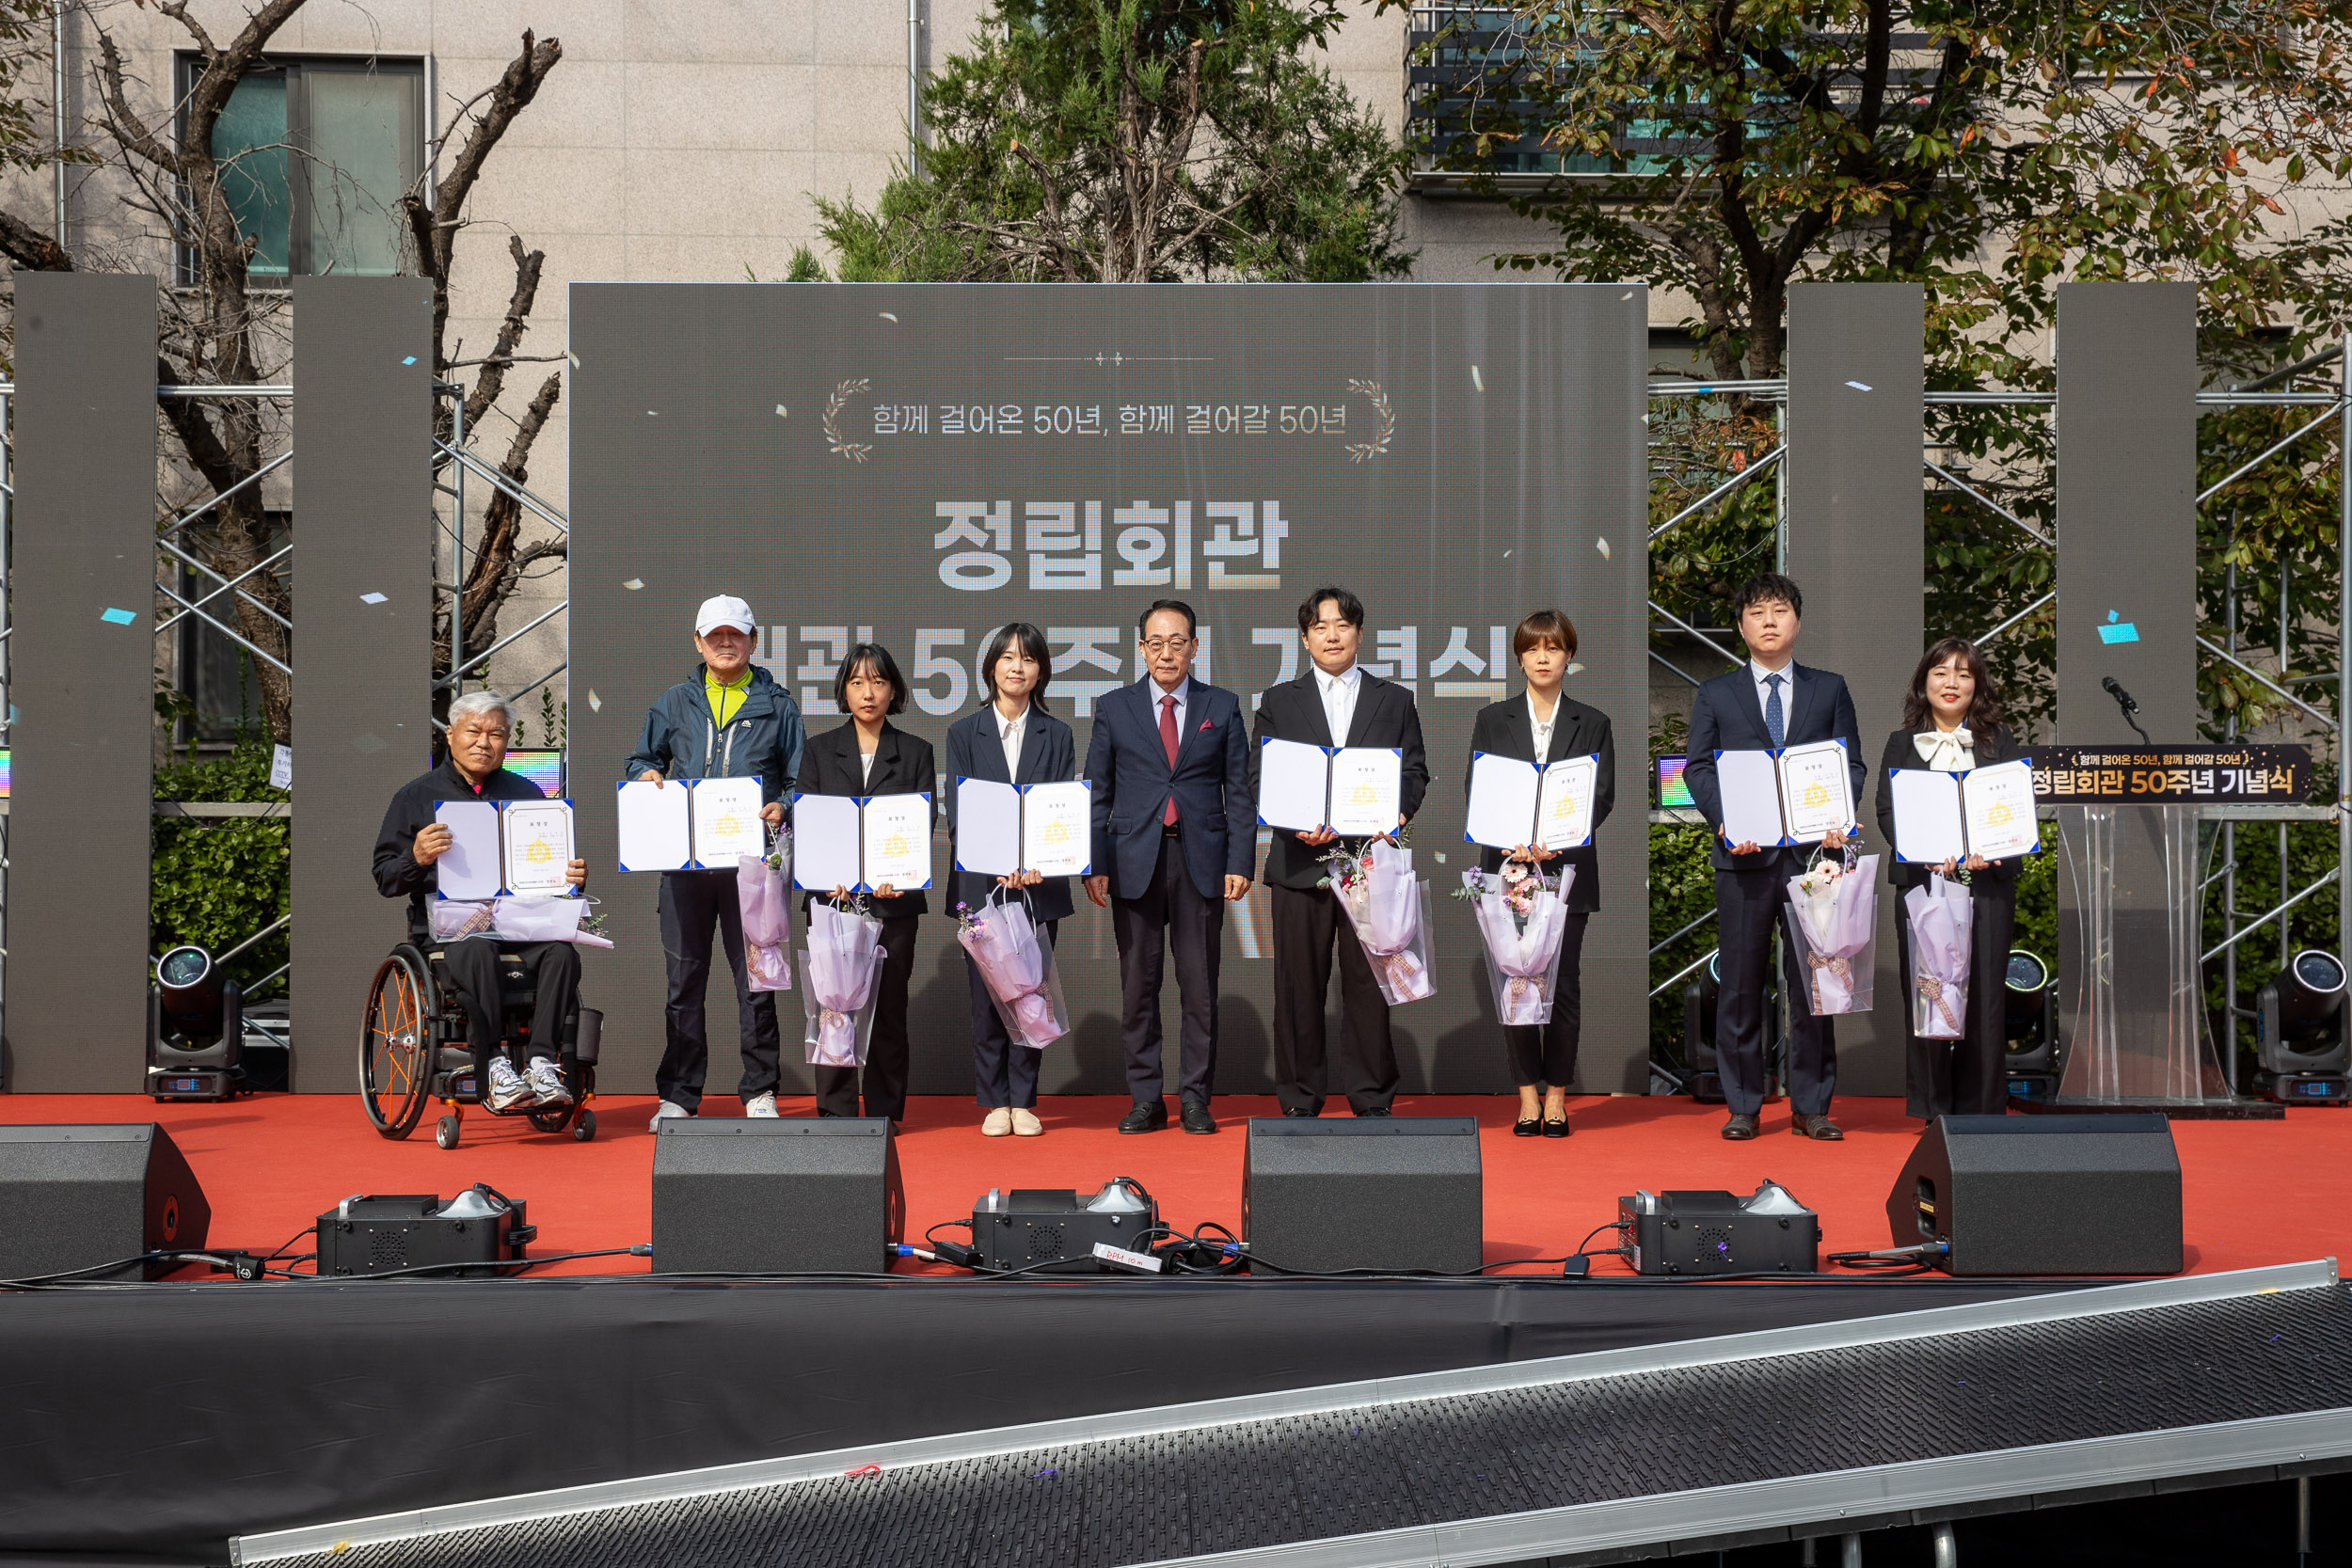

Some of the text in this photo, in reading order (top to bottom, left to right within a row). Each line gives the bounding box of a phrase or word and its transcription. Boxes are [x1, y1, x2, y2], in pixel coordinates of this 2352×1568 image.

[873, 404, 1346, 436] 함께 걸어온 50년, 함께 걸어갈 50년
[934, 499, 1289, 591] 정립회관
[2080, 754, 2241, 767] 함께 걸어온 50년, 함께 걸어갈 50년
[2032, 768, 2293, 796] 정립회관 50주년 기념식
